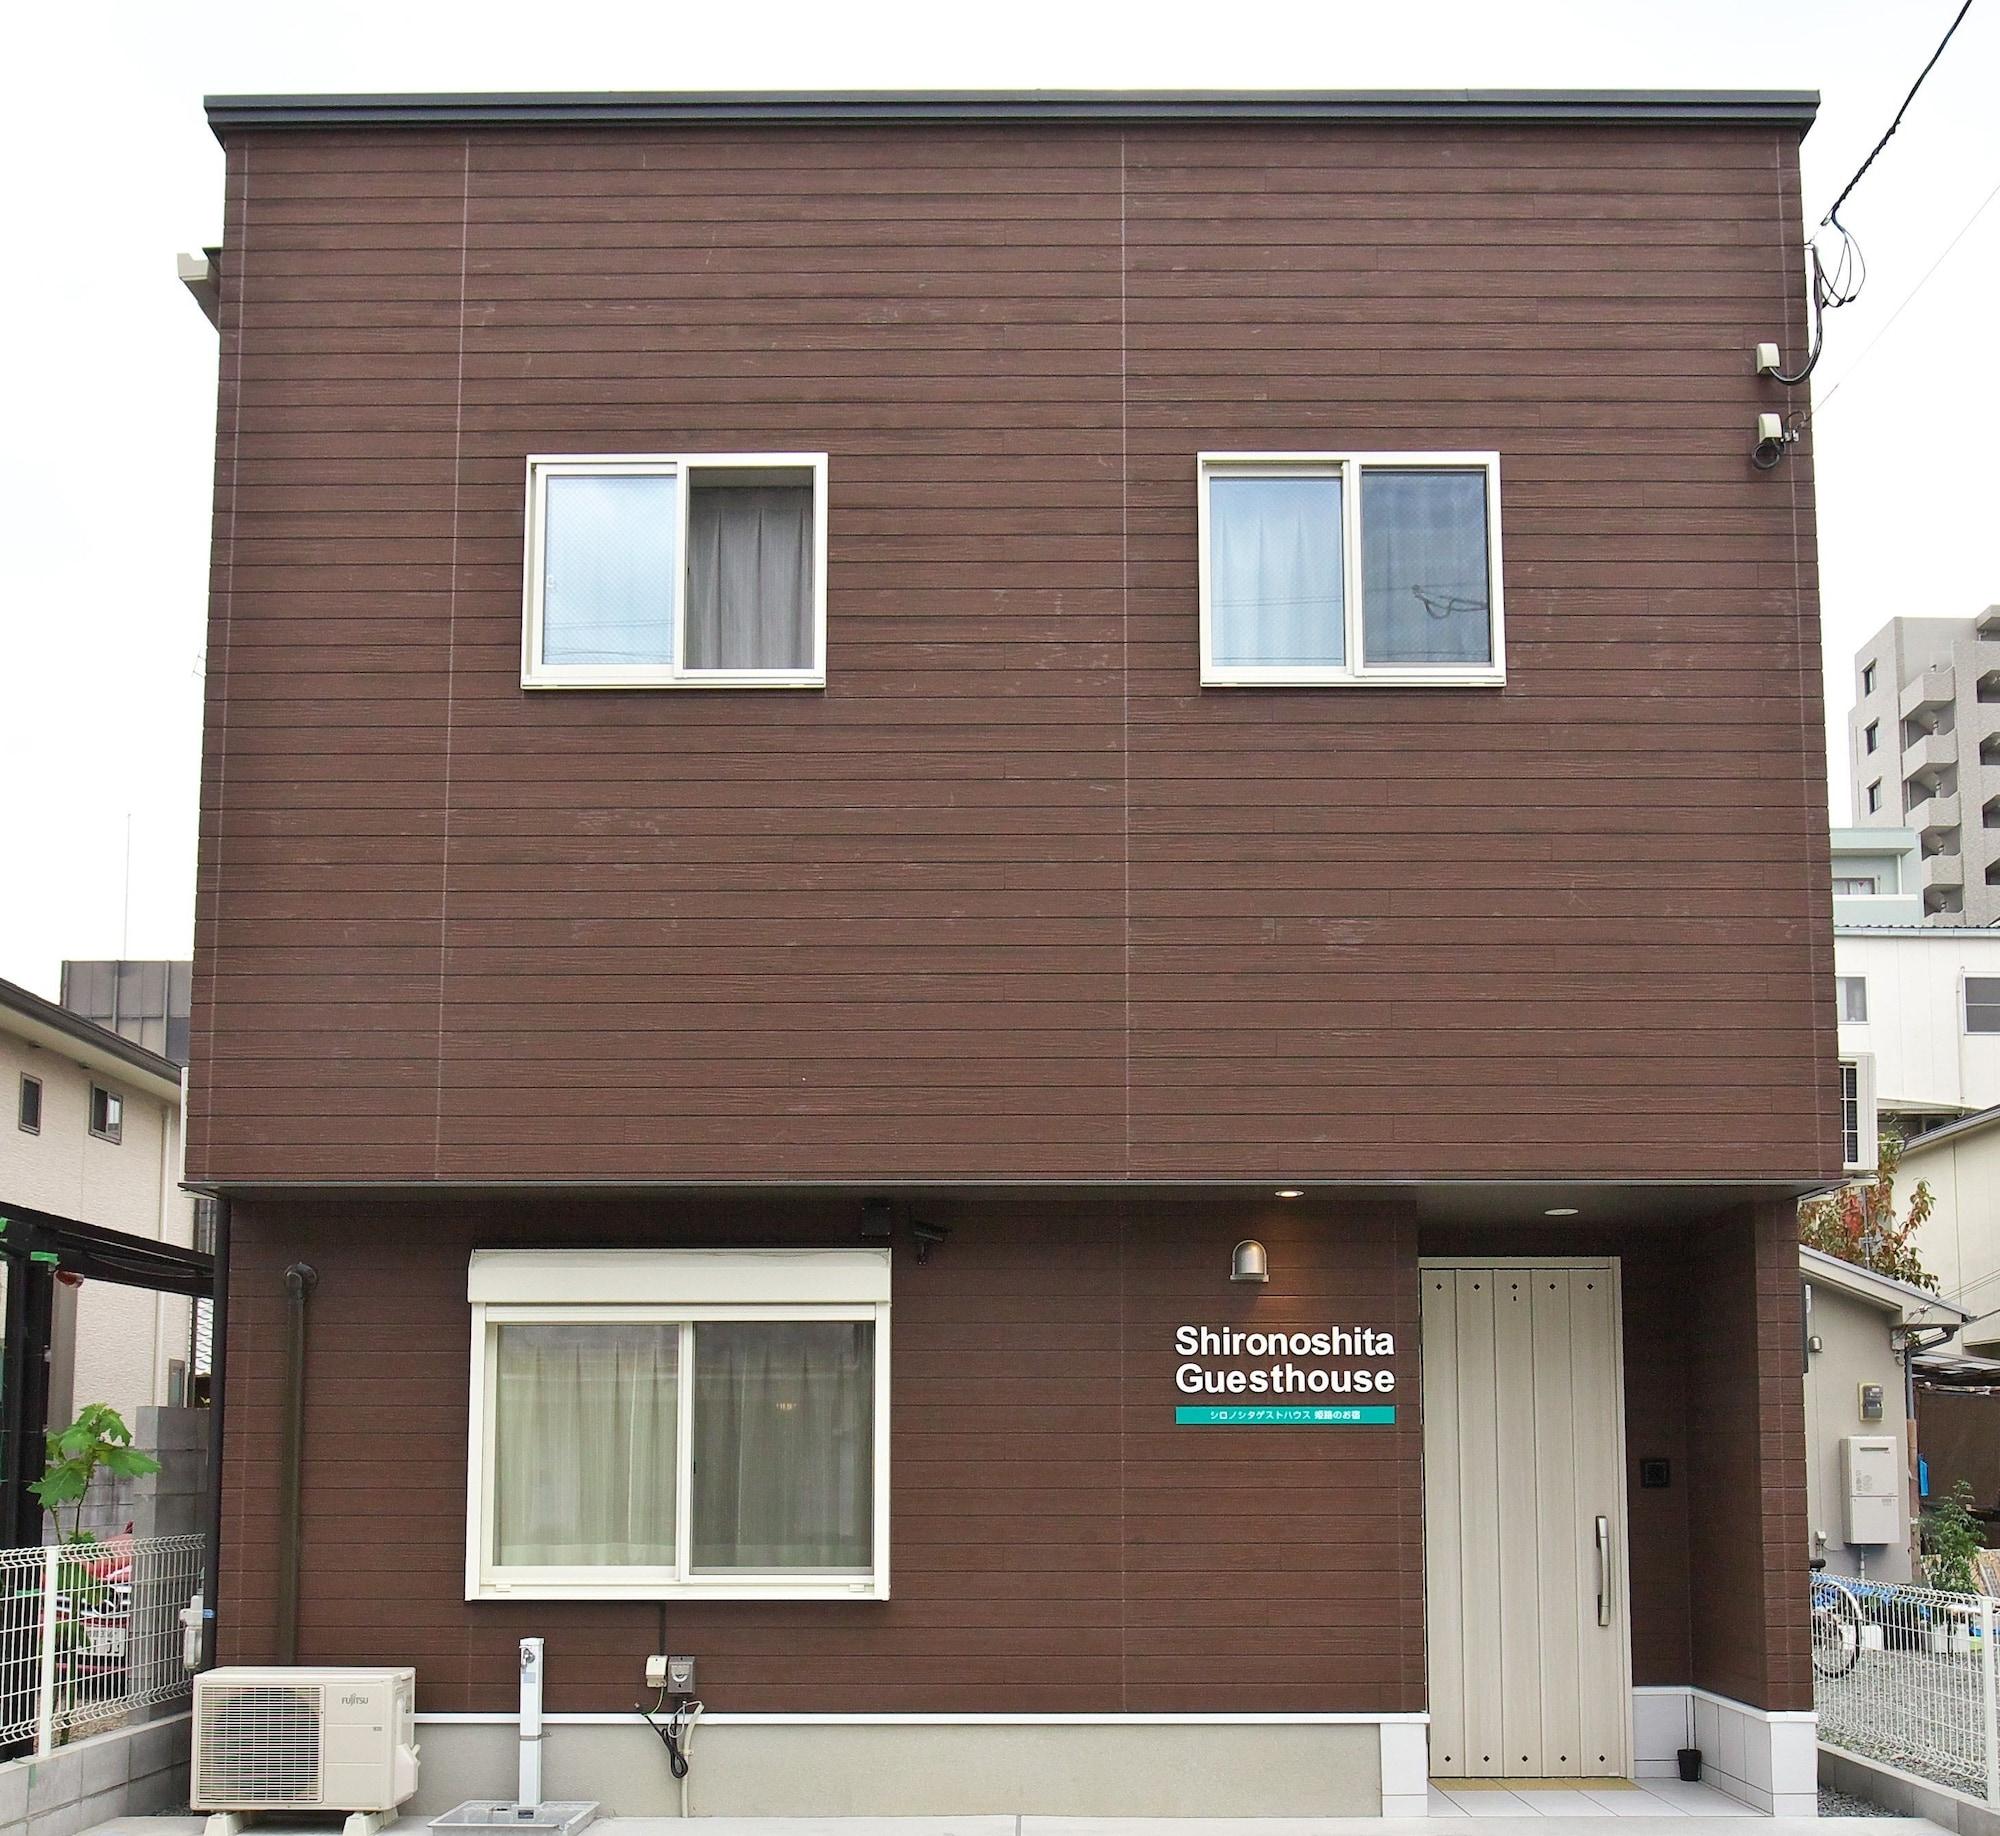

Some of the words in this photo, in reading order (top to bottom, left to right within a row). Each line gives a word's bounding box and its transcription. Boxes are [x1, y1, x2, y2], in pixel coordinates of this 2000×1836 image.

[1175, 1325, 1395, 1356] Shironoshita
[1175, 1363, 1395, 1393] Guesthouse
[1210, 1410, 1311, 1420] シロノシタゲストハウス
[341, 1692, 369, 1706] FUJITSU
